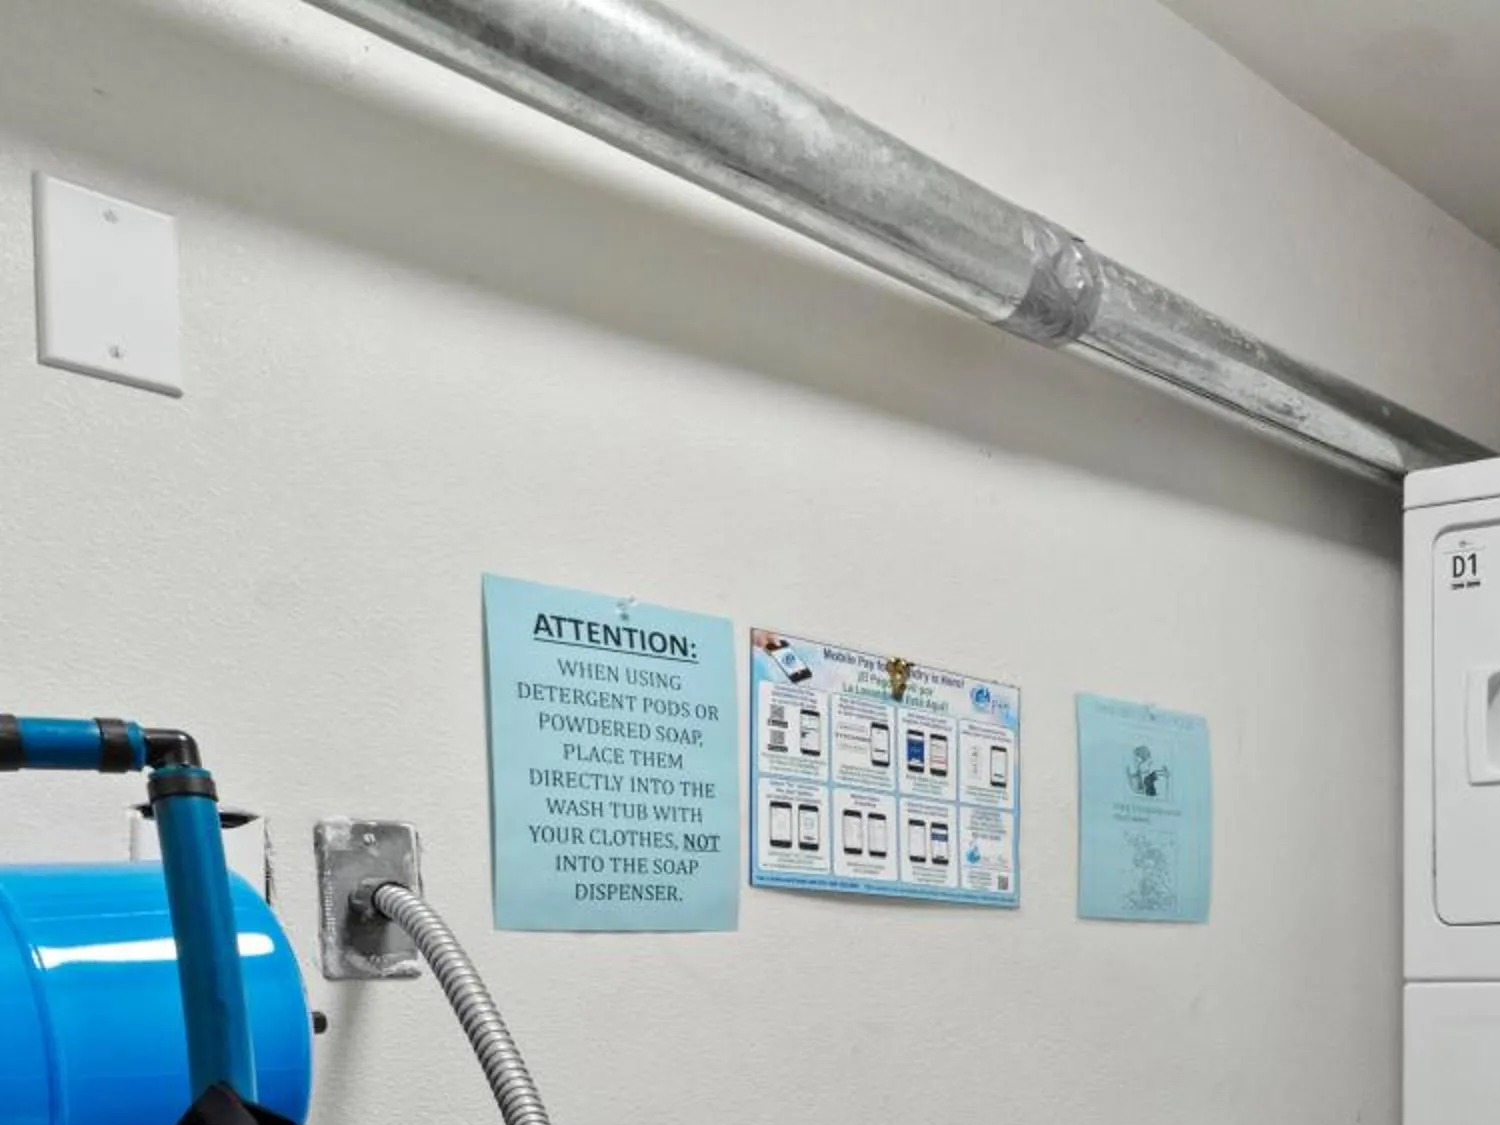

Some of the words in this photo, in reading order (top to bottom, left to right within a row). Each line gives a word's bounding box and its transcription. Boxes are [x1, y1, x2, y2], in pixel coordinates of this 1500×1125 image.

[1452, 553, 1477, 578] D1
[533, 613, 699, 662] ATTENTION:
[557, 658, 619, 683] WHEN
[626, 667, 681, 691] USING
[517, 681, 637, 713] DETERGENT
[643, 697, 690, 718] PODS
[695, 703, 719, 721] OR
[539, 711, 650, 741] POWDERED
[655, 725, 703, 748] SOAP,
[563, 743, 625, 765] PLACE
[630, 749, 683, 769] THEM
[529, 768, 624, 793] DIRECTLY
[630, 776, 675, 795] INTO
[680, 781, 716, 799] THE
[546, 797, 603, 818] WASH
[609, 800, 648, 821] TUB
[653, 805, 703, 823] WITH
[528, 825, 584, 845] YOUR
[590, 828, 679, 850] CLOTHES,
[684, 833, 721, 852] NOT
[556, 855, 605, 873] INTO
[609, 857, 648, 874] THE
[653, 858, 699, 875] SOAP
[575, 883, 683, 902] DISPENSER.
